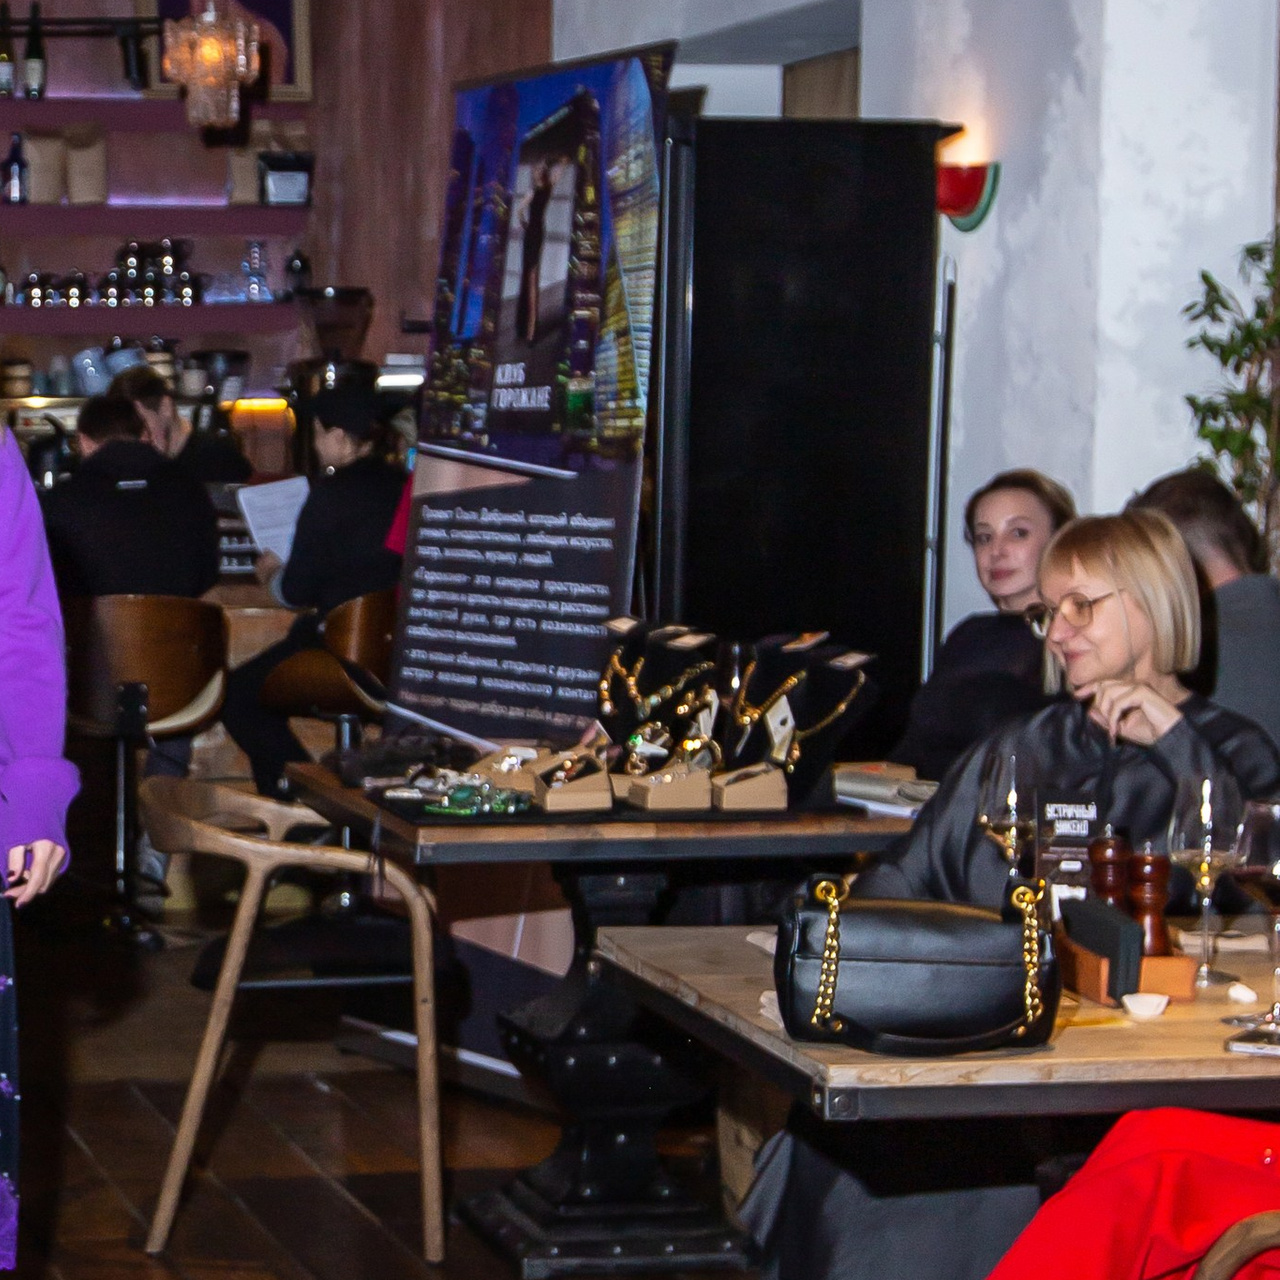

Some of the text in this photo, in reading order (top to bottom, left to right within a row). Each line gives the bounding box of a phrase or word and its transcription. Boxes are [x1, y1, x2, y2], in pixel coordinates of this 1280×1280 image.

[496, 362, 526, 385] КЛУБ
[491, 386, 552, 411] ГОРОЖАНЕ
[1045, 801, 1097, 821] УСТРИЧНЫЙ
